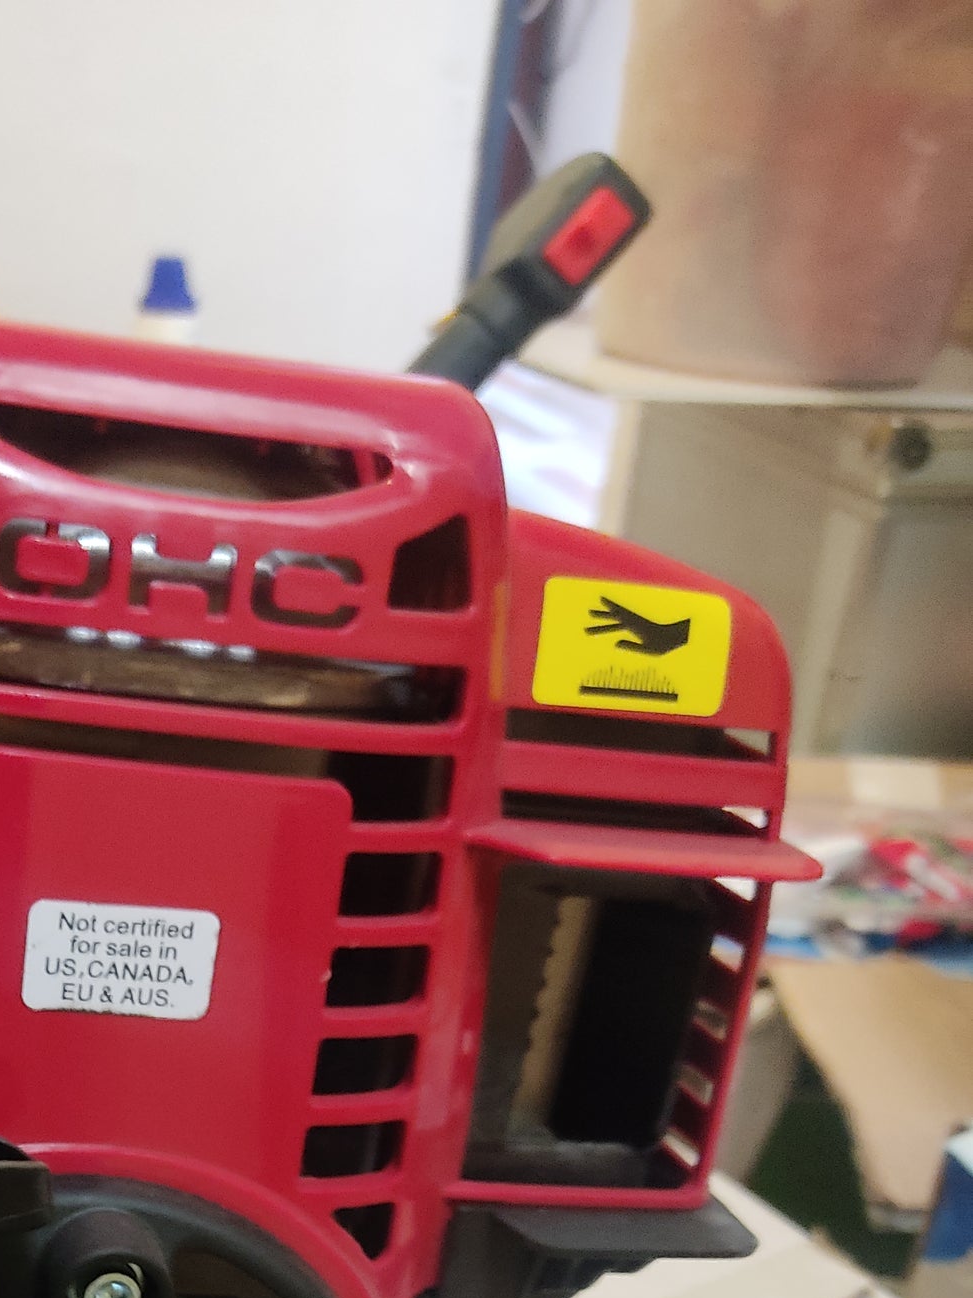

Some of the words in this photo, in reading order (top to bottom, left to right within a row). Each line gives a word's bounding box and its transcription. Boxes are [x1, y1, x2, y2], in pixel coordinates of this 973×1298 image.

[58, 911, 97, 933] Not
[103, 918, 195, 940] certified
[70, 935, 102, 954] for
[106, 940, 152, 959] sale
[159, 942, 178, 961] in
[61, 982, 94, 1002] EU
[99, 986, 113, 1004] &
